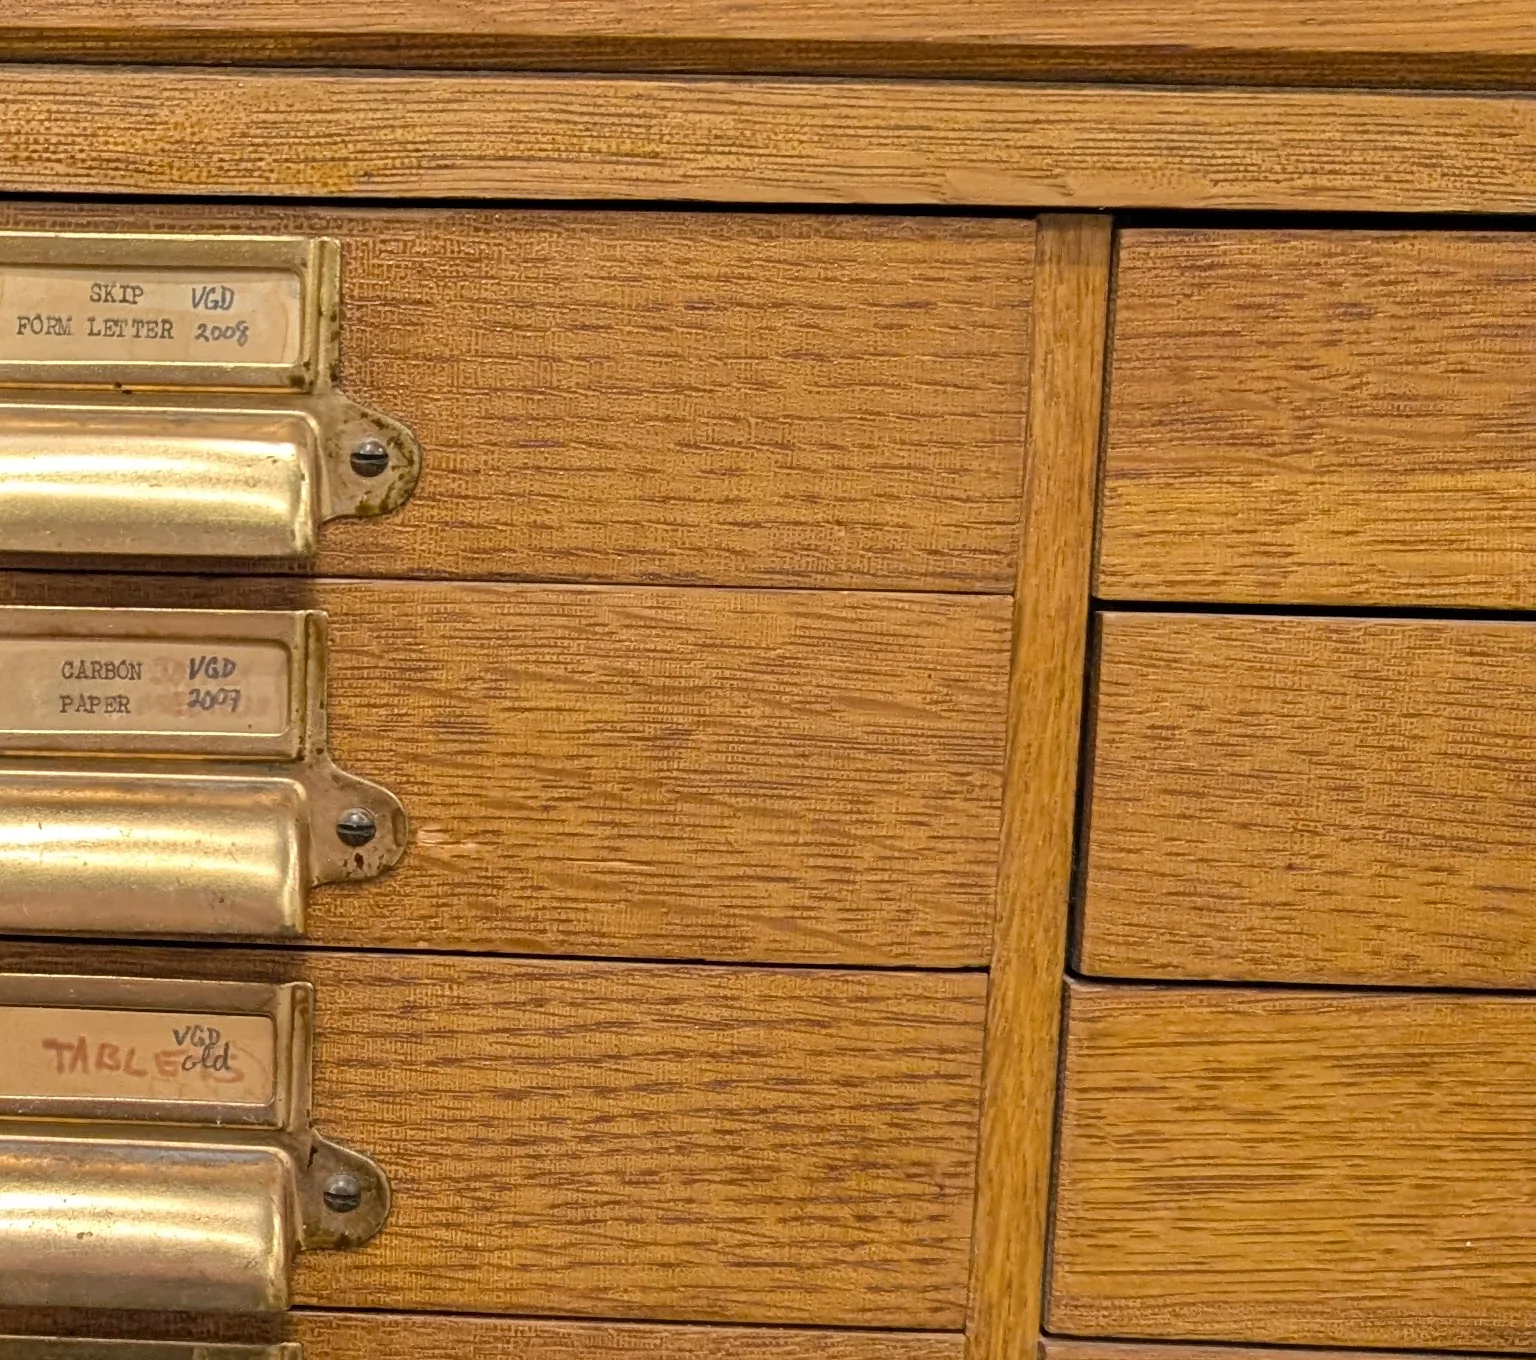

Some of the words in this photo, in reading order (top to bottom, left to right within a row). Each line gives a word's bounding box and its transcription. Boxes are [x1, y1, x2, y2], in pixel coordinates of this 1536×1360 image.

[89, 282, 144, 305] SKIP
[191, 285, 235, 311] VGD
[16, 314, 73, 337] FORM
[87, 316, 174, 340] LETTER
[194, 320, 249, 347] 2008
[61, 659, 143, 681] CARBON
[188, 656, 237, 680] VGD
[59, 694, 131, 715] PAPER
[187, 686, 241, 712] 2007
[172, 1025, 221, 1047] VGD
[181, 1041, 230, 1072] old
